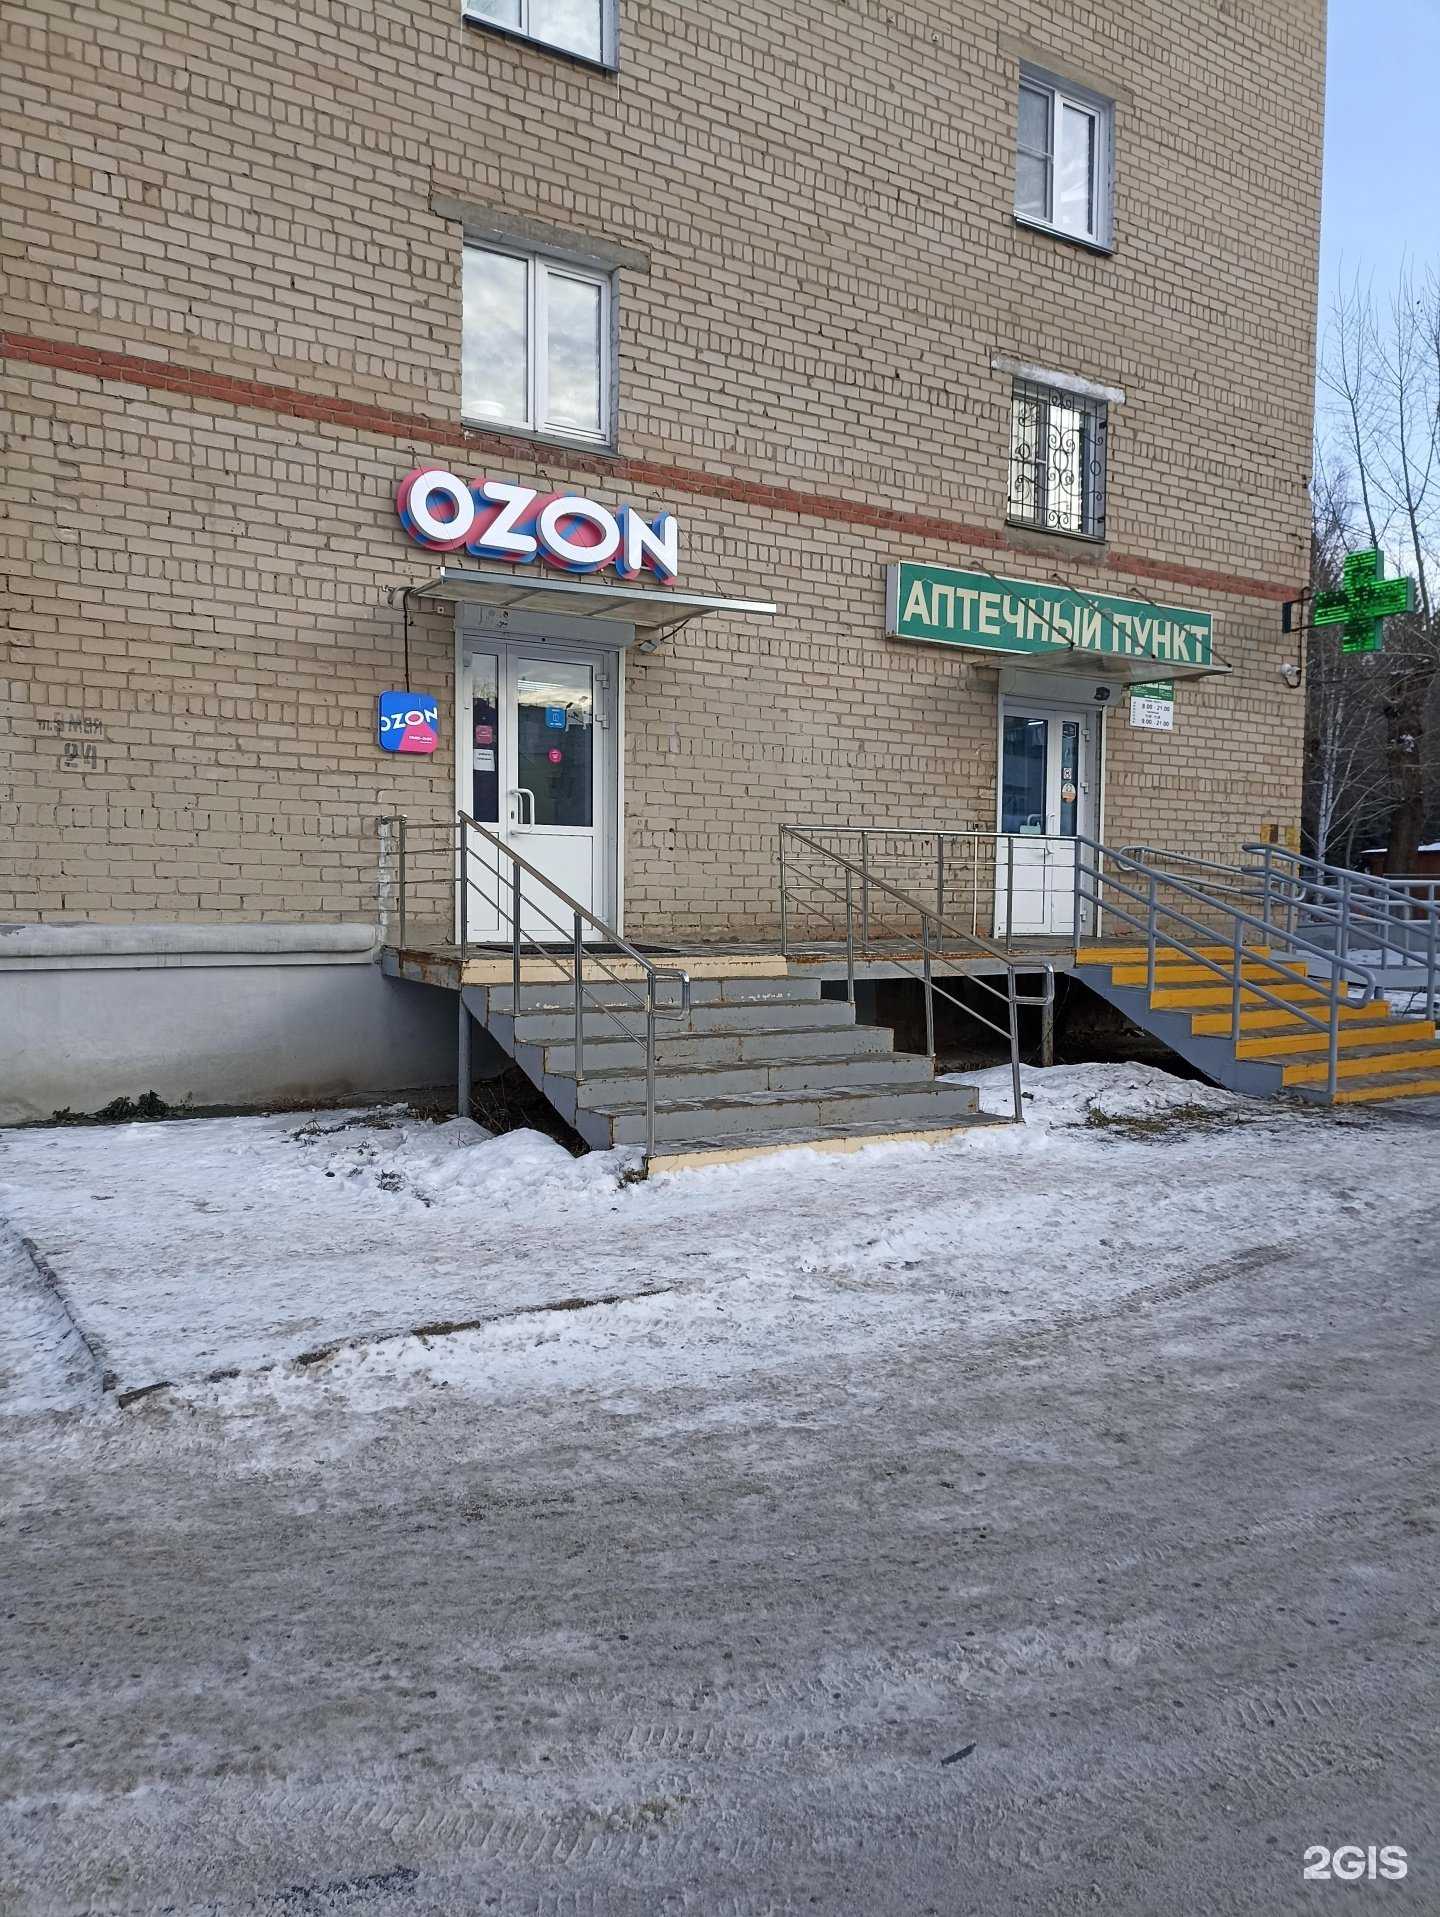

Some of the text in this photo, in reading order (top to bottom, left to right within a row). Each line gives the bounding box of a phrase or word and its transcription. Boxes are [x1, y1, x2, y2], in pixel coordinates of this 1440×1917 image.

[408, 470, 678, 577] OZON
[902, 580, 1209, 663] АПТЕЧНЫЙ ПУНКТ
